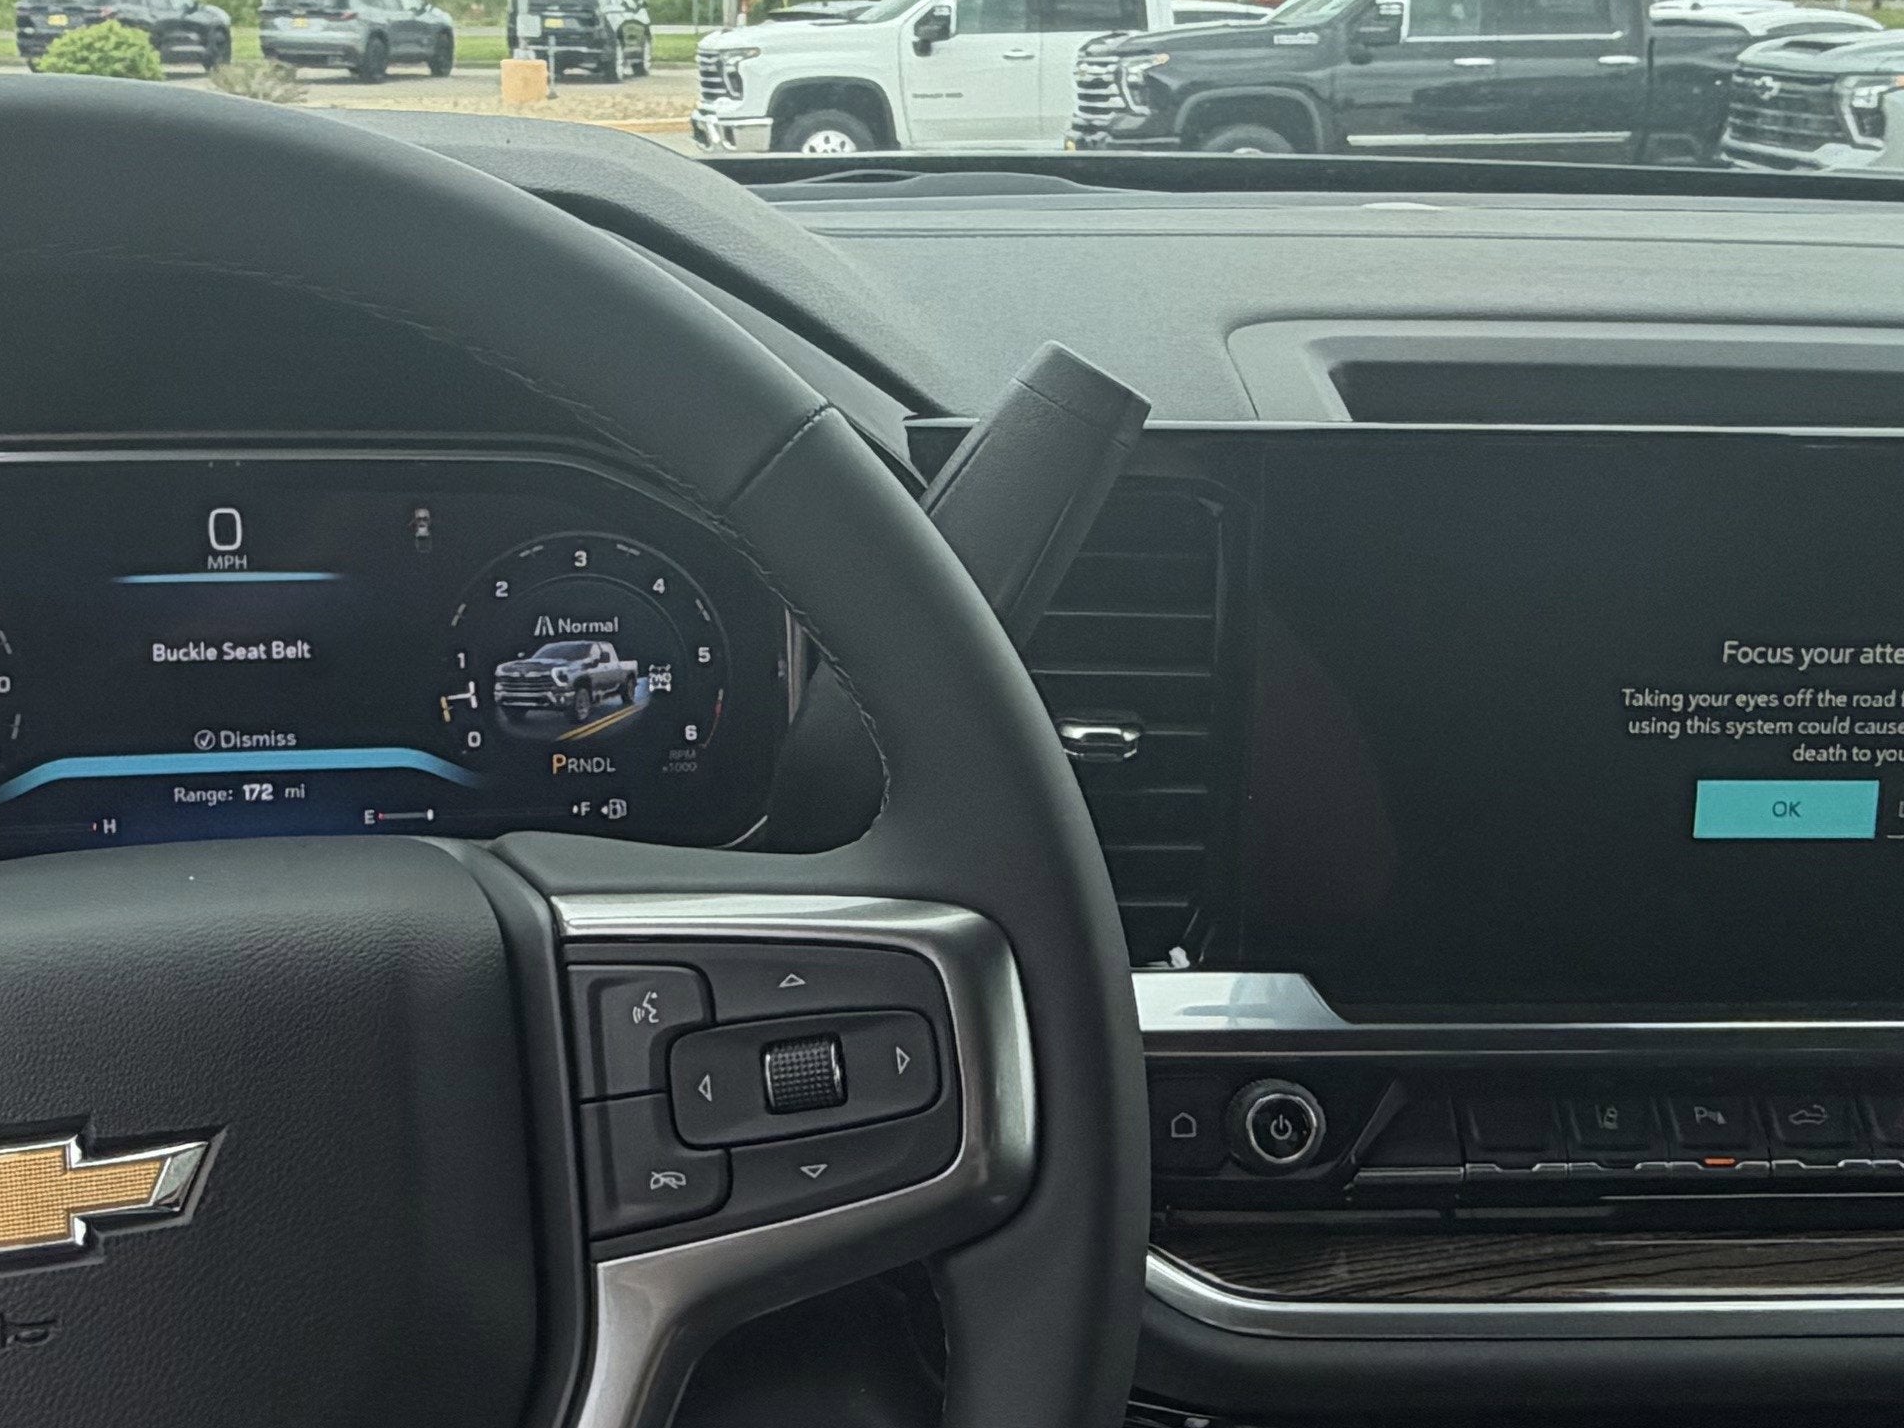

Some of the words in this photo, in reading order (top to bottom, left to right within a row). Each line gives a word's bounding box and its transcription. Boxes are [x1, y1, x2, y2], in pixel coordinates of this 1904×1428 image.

[207, 507, 243, 552] 0
[207, 554, 248, 570] MPH
[574, 550, 588, 567] 3
[495, 580, 509, 598] 2
[651, 576, 667, 594] 4
[557, 615, 620, 634] Normal
[151, 641, 218, 662] Buckle
[222, 641, 267, 661] Seat
[271, 639, 312, 660] Belt
[697, 646, 712, 664] 5
[1722, 640, 1795, 665] Focus
[1798, 645, 1855, 671] your
[457, 651, 467, 669] 1
[1622, 688, 1684, 712] Taking
[1687, 693, 1732, 713] your
[1735, 693, 1780, 713] eyes
[1783, 689, 1814, 708] off
[1817, 689, 1847, 708] the
[1852, 689, 1897, 708] road
[684, 724, 699, 742] 6
[1628, 718, 1681, 740] using
[1686, 716, 1721, 735] this
[1725, 719, 1794, 740] system
[1797, 716, 1851, 736] could
[219, 729, 297, 749] Dismiss
[466, 730, 482, 748] 0
[1792, 744, 1847, 763] death
[1851, 746, 1871, 763] to
[174, 785, 234, 807] Range:
[241, 782, 275, 802] 172
[284, 783, 307, 800] mi
[363, 809, 376, 825] E
[579, 801, 592, 817] F
[1771, 800, 1802, 819] OK
[102, 818, 117, 834] H
